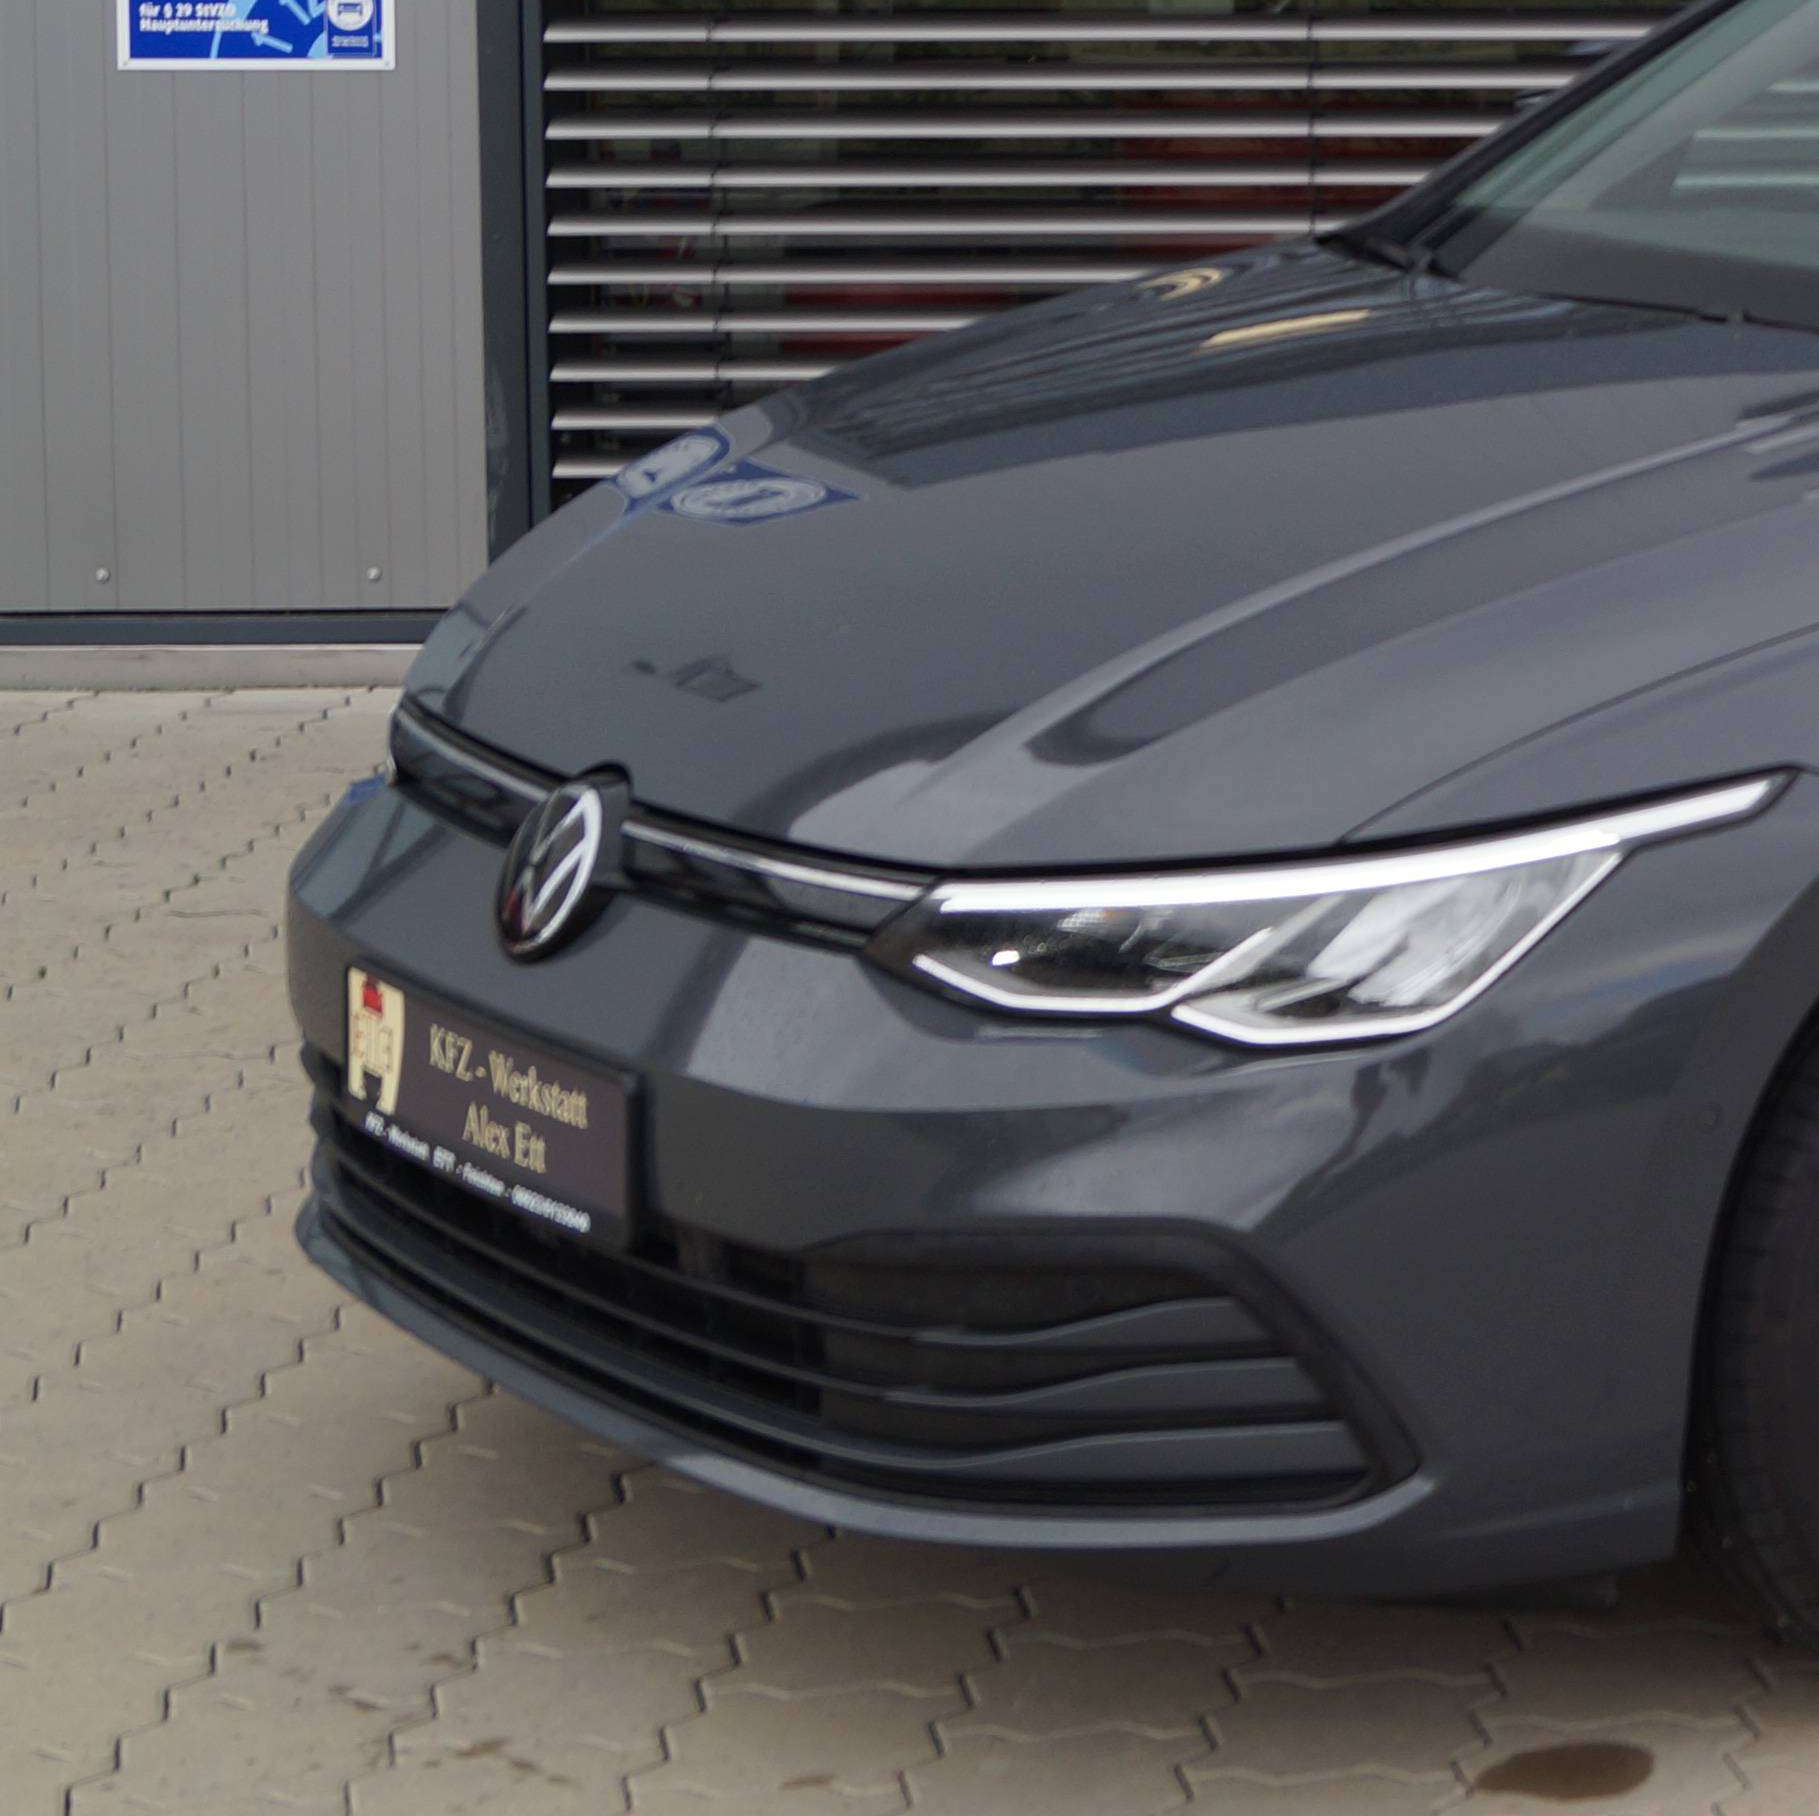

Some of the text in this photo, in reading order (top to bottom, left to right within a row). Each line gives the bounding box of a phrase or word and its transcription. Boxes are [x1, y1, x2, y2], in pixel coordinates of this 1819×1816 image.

[429, 1022, 473, 1082] KFZ
[487, 1050, 590, 1130] Werkstatt
[462, 1100, 548, 1174] Alex Ett
